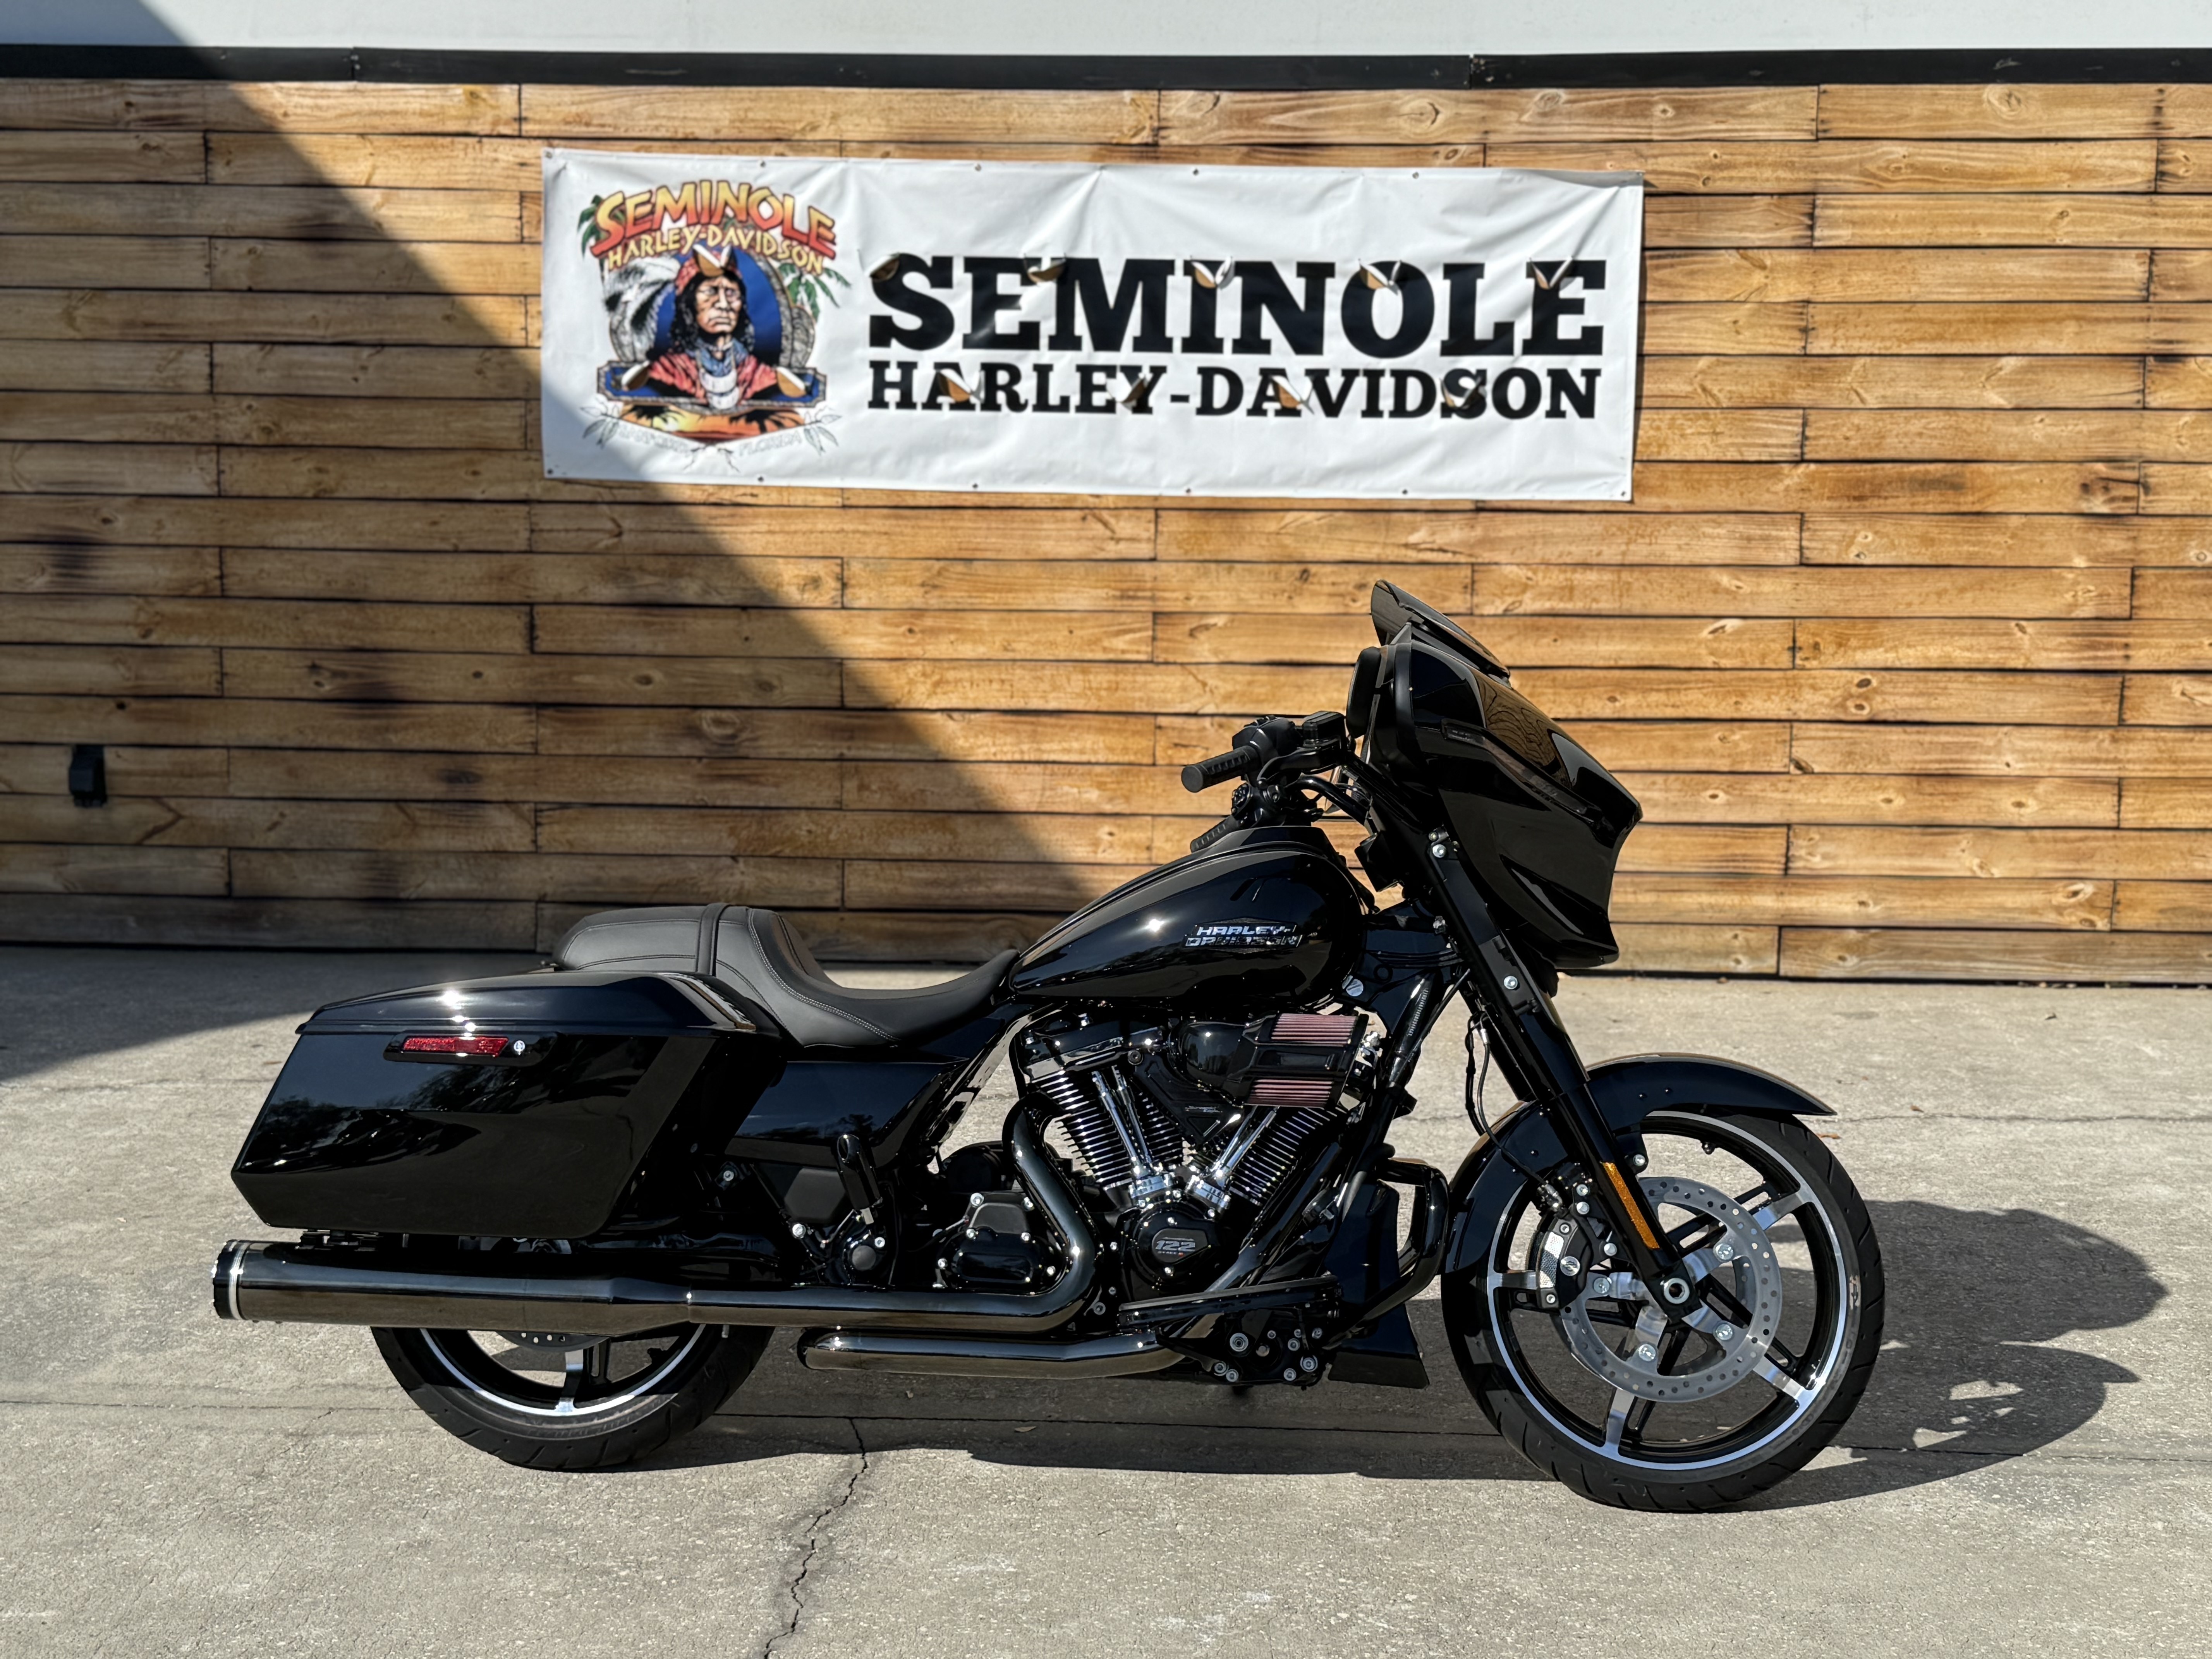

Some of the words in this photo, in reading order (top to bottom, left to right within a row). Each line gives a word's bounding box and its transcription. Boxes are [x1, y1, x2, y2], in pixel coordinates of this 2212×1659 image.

[589, 180, 836, 260] SEMINOLE
[607, 225, 826, 276] HARLEY-DAVIDSON
[869, 253, 1606, 359] SEMINOLE
[868, 360, 1601, 419] HARLEY-DAVIDSON
[1155, 1240, 1196, 1252] 122
